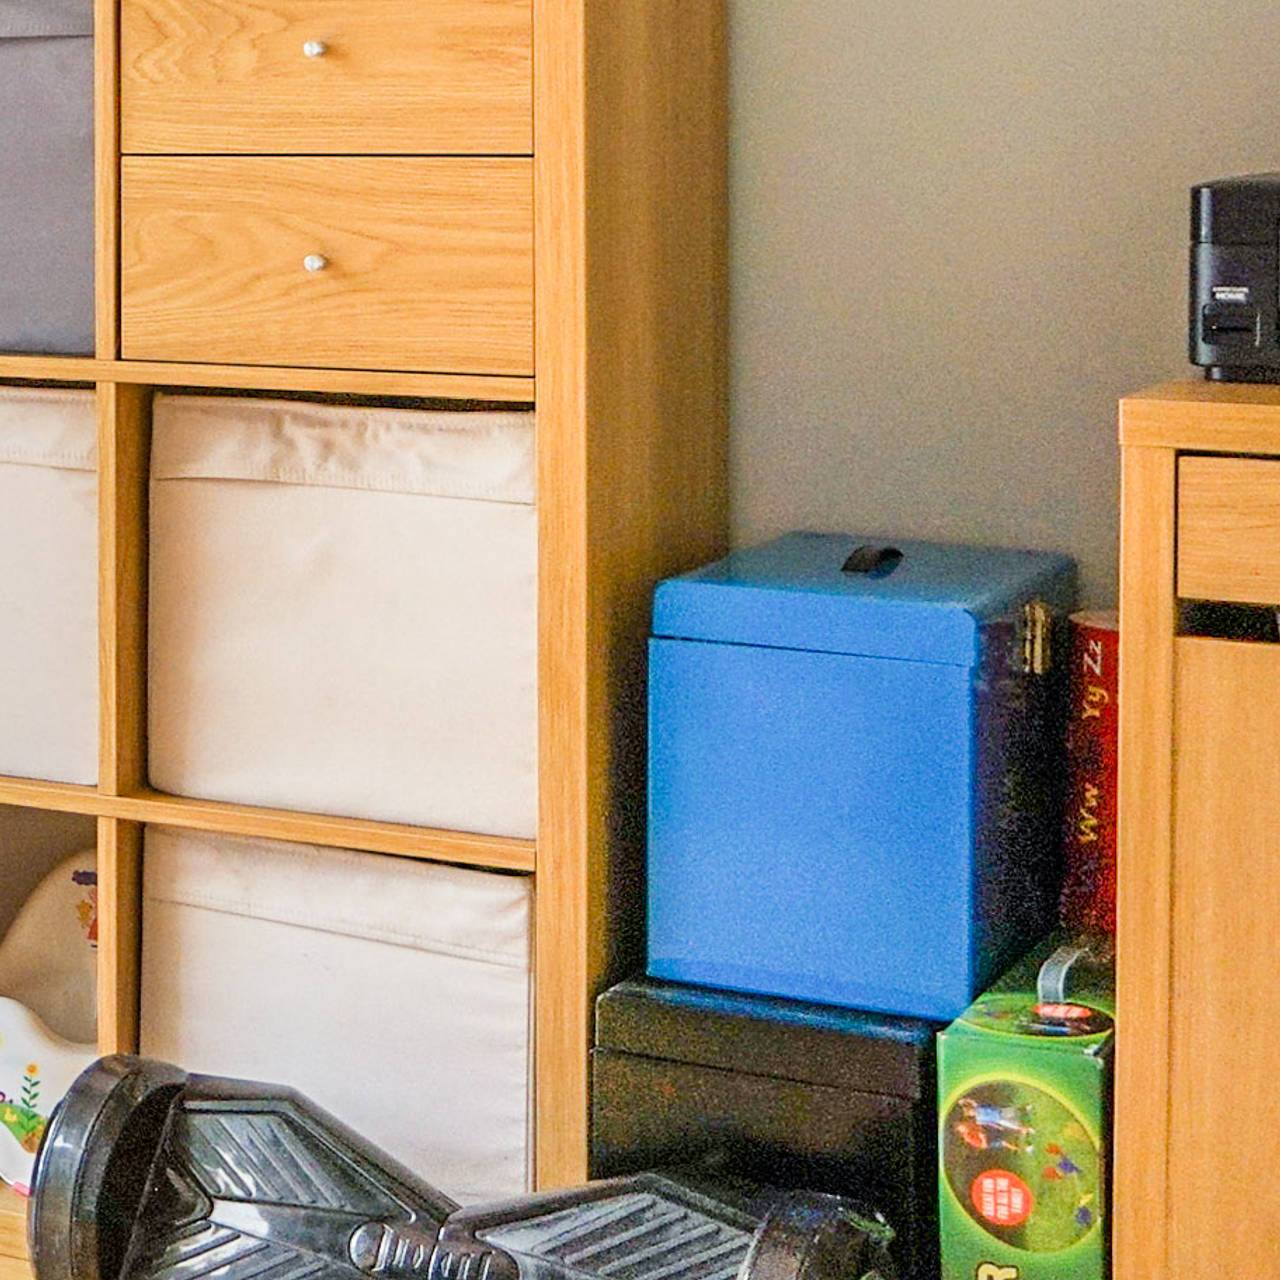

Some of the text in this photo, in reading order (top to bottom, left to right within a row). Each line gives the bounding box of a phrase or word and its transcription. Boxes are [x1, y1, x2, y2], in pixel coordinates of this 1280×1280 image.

[1077, 639, 1108, 842] Ww Yy Zz
